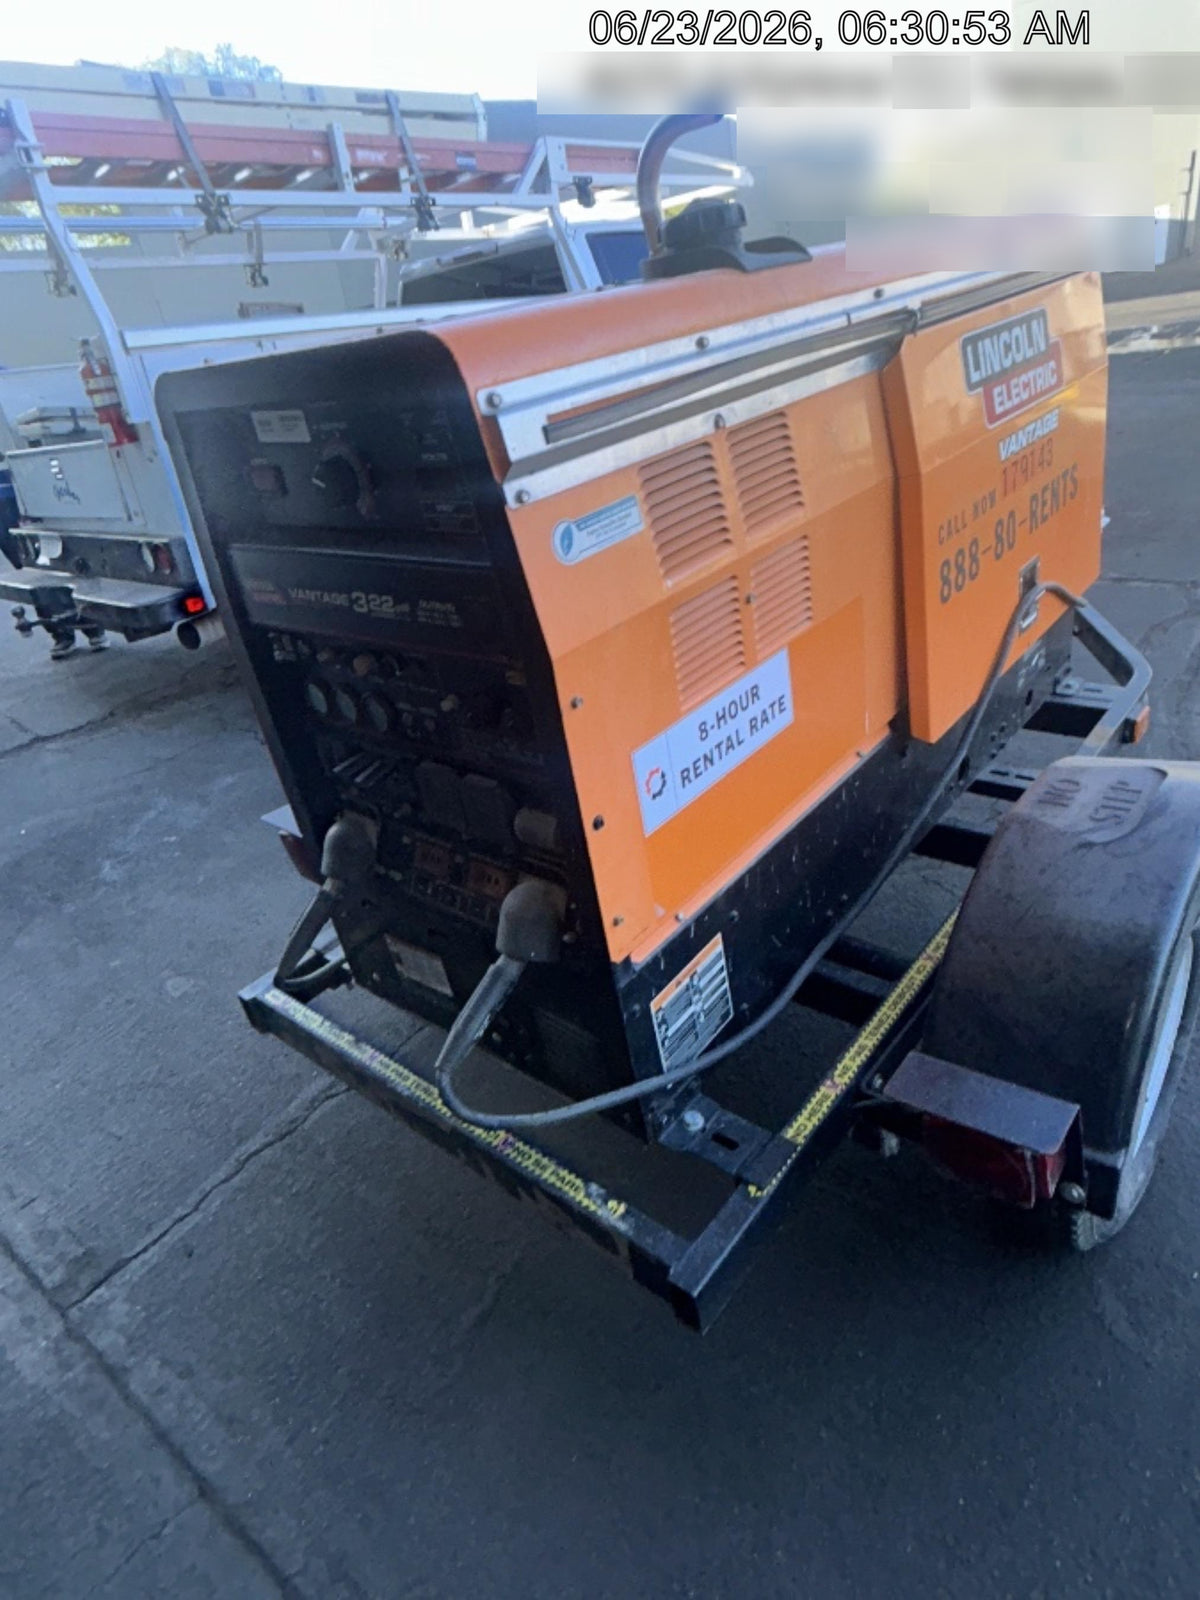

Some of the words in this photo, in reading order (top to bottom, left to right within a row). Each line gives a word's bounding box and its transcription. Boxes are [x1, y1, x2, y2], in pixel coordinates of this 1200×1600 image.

[965, 316, 1049, 384] LINCOLN
[992, 359, 1058, 414] ELECTRIC
[998, 408, 1061, 461] VANTAGE
[937, 514, 968, 547] CALL
[972, 488, 998, 522] NOW
[939, 463, 1080, 604] 888-80-RENTS
[288, 587, 350, 608] VANTAGE
[697, 683, 762, 741] 8-HOUR
[679, 732, 746, 789] RENTAL
[749, 694, 788, 740] RATE
